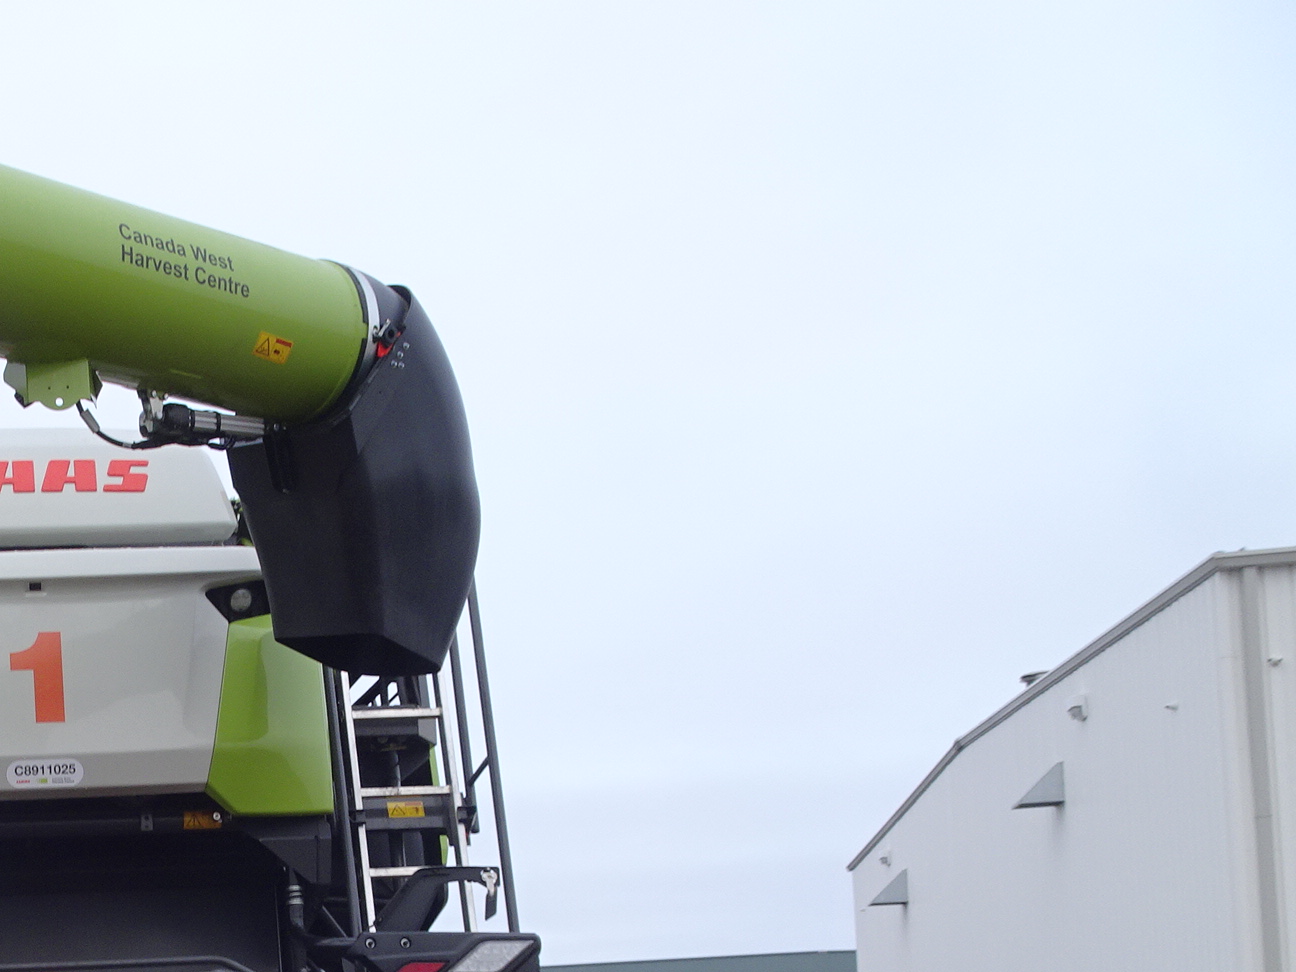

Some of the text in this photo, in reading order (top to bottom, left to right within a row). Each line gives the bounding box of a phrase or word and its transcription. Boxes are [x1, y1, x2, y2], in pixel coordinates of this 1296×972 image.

[119, 223, 234, 271] Canada West
[121, 244, 250, 298] Harvest Centre
[9, 631, 66, 724] 1
[14, 763, 76, 776] C8911025
